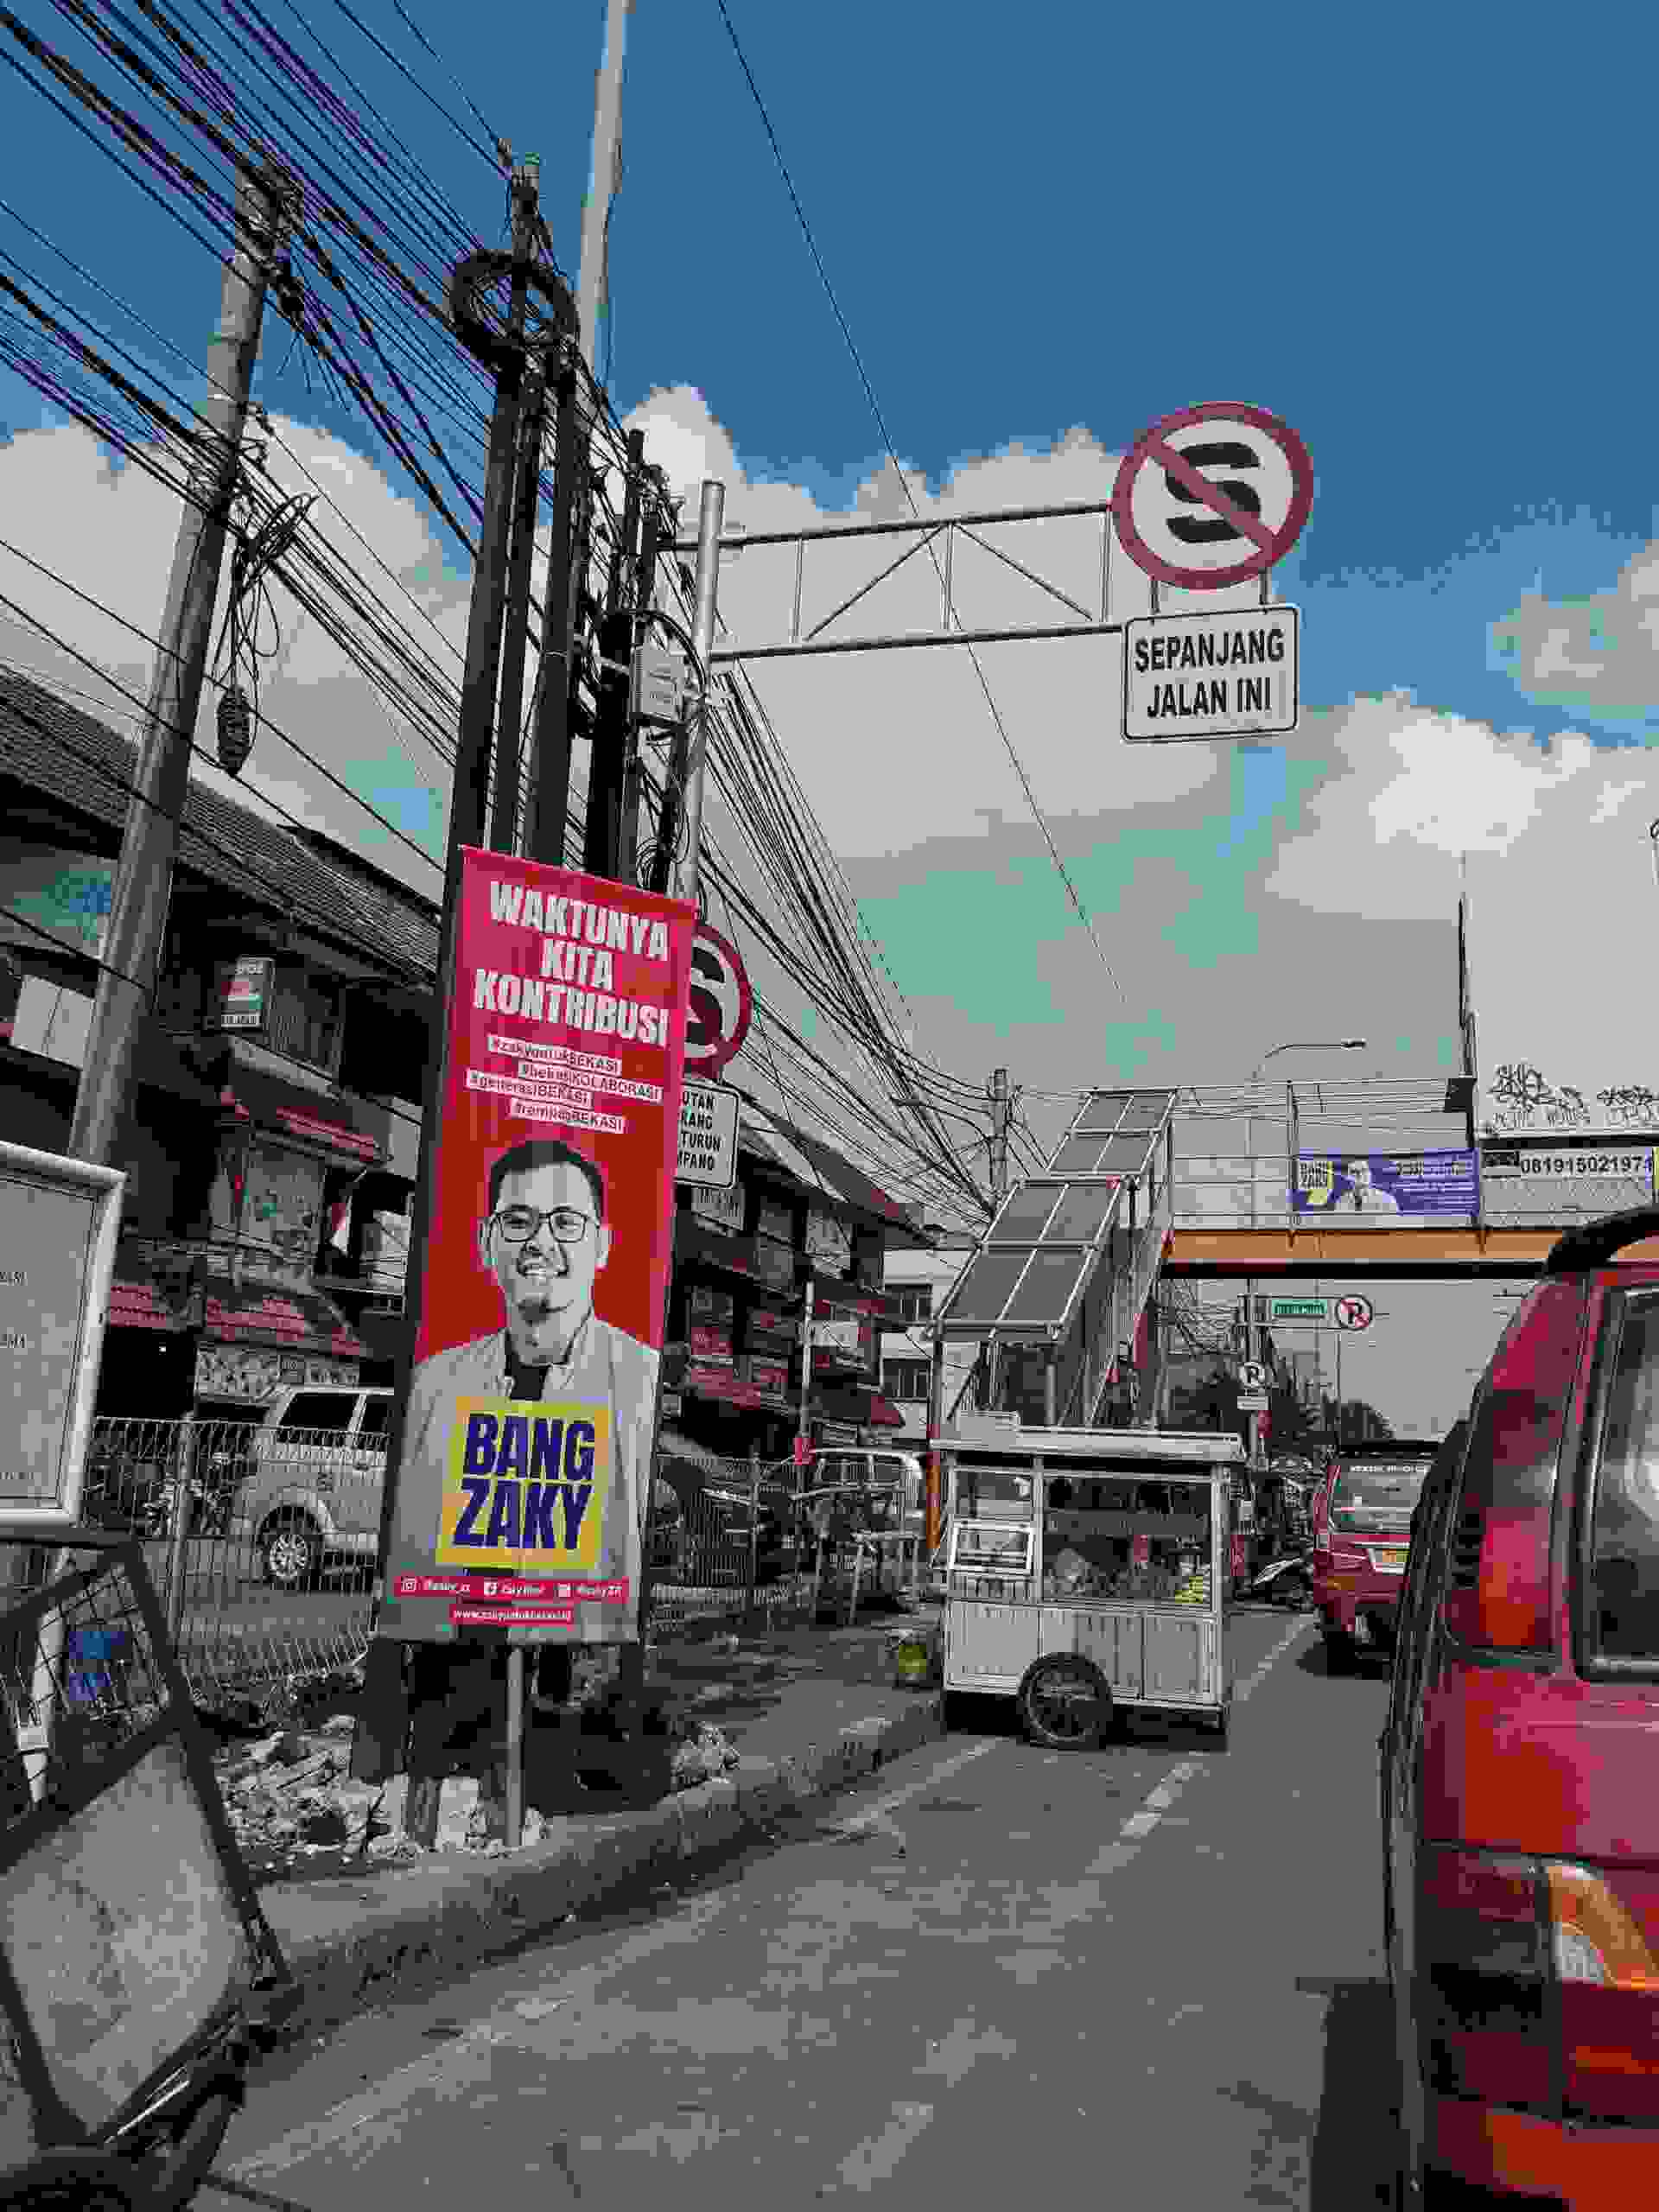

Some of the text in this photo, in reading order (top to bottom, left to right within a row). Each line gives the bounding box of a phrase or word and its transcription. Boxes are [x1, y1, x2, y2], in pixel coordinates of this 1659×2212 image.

[1135, 629, 1284, 671] SEPANJANG
[1147, 677, 1271, 717] JALAN INI
[490, 880, 668, 961] WAKTUNYA
[541, 938, 613, 991] KITA
[474, 969, 668, 1048] KONTRIBUSI
[678, 1109, 713, 1130] RANG
[682, 1091, 714, 1110] UTAN
[463, 1414, 595, 1480] BANG
[453, 1478, 595, 1550] ZAKY
